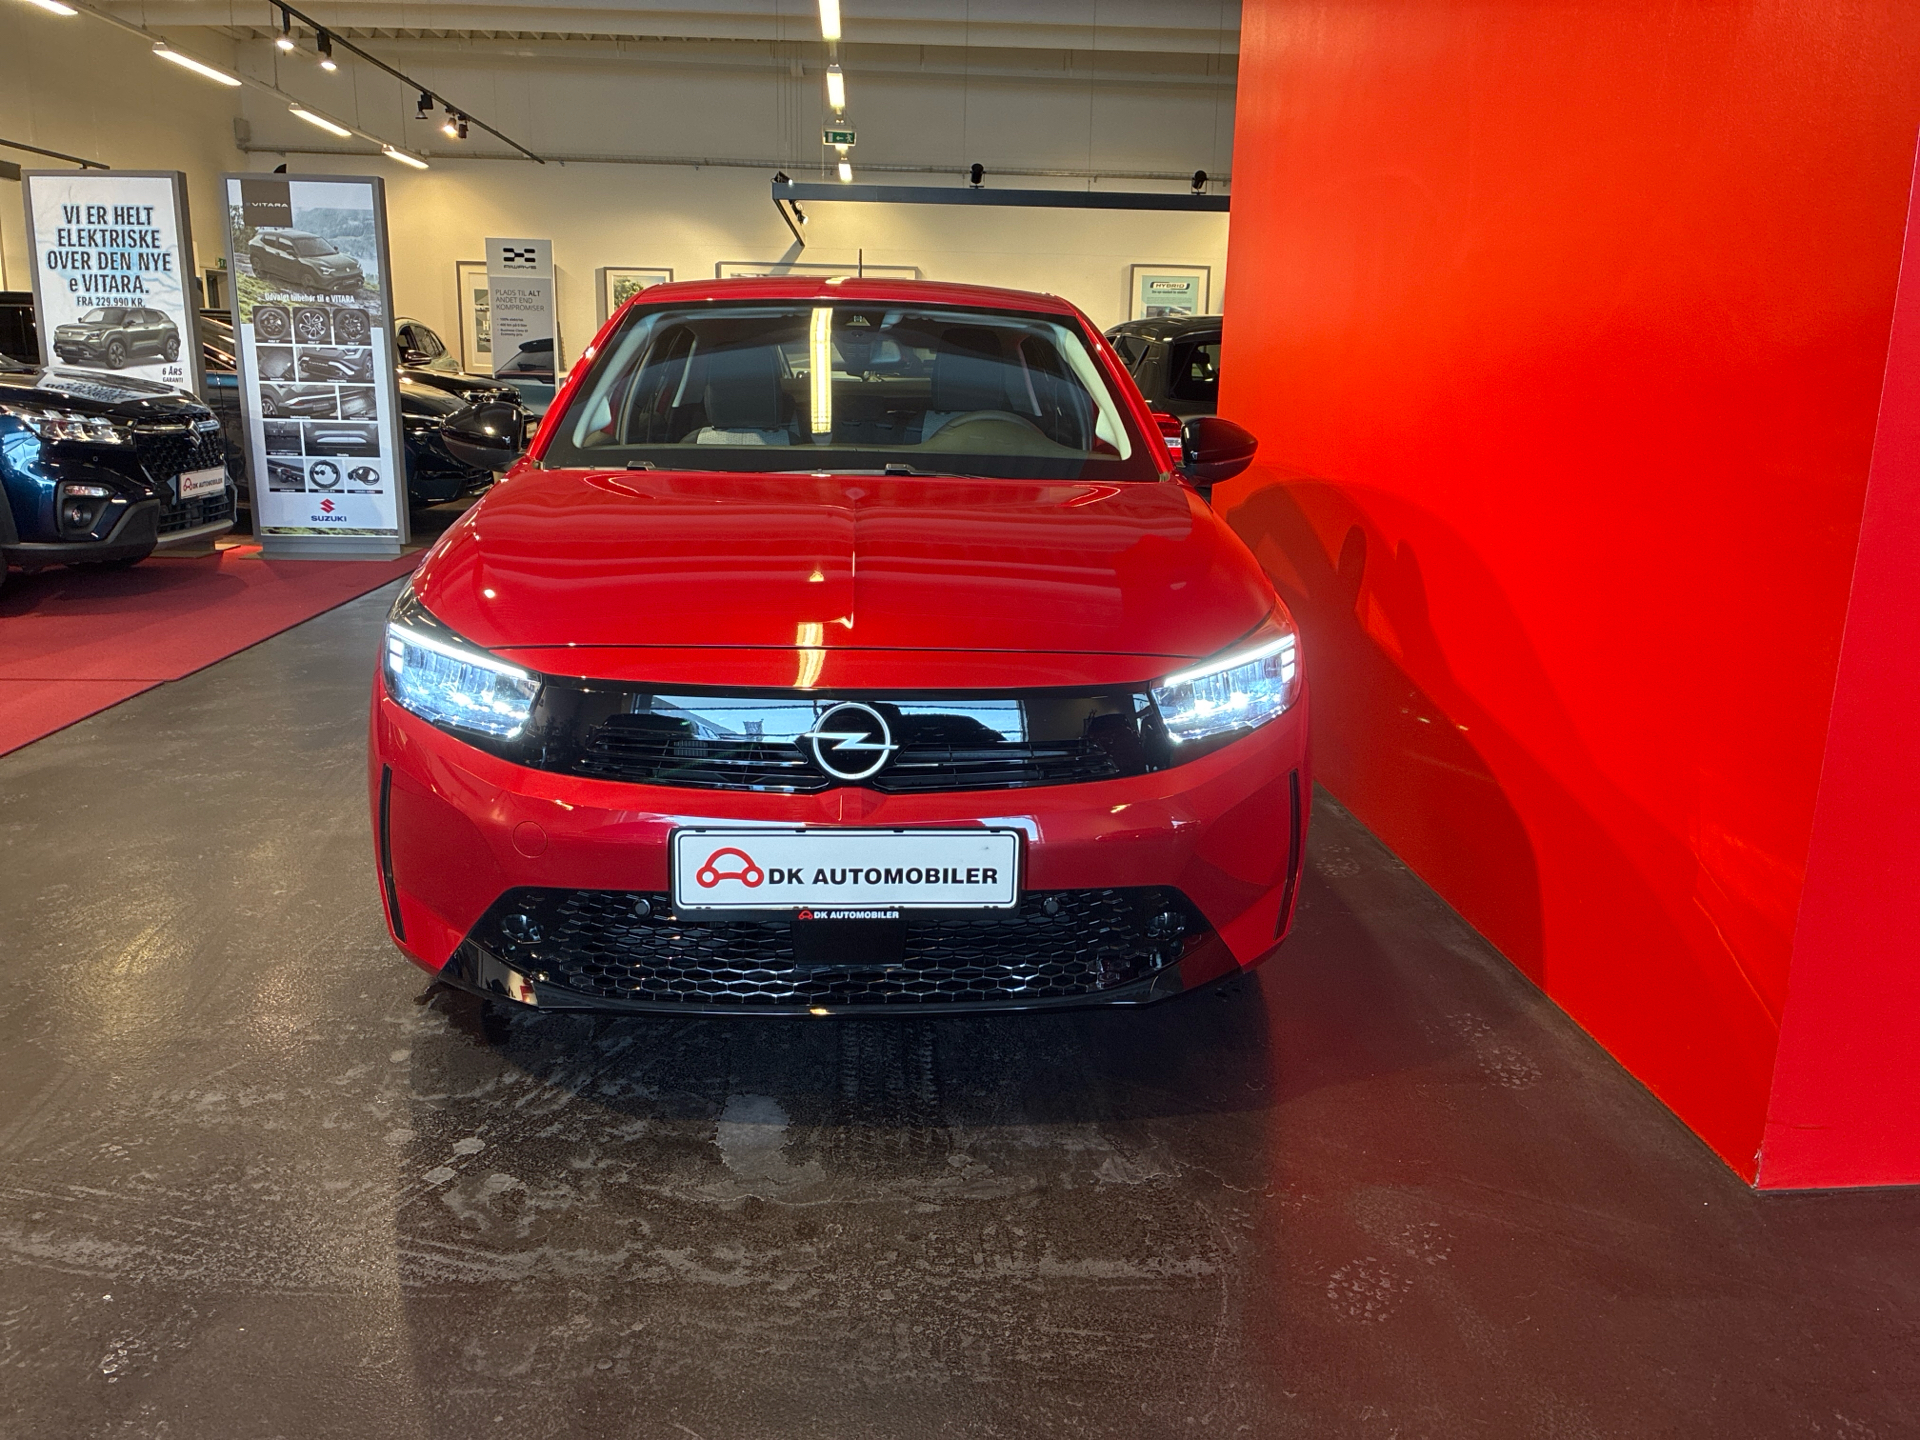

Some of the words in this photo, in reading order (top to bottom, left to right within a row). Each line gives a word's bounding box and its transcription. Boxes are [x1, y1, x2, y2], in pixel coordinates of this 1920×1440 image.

[64, 206, 80, 224] VI
[87, 206, 108, 225] ER
[114, 207, 154, 225] HELT
[57, 228, 161, 249] ELEKTRISKE
[47, 250, 91, 270] OVER
[97, 252, 131, 271] DEN
[138, 252, 171, 271] NYE
[69, 277, 78, 292] e
[81, 274, 150, 294] VITARA.
[76, 297, 93, 306] FRA
[95, 297, 129, 307] 229.990
[330, 295, 355, 303] VITARA
[162, 368, 167, 376] 6
[168, 365, 183, 376] ÅRS
[769, 868, 805, 885] DK
[812, 867, 998, 885] AUTOMOBILER
[813, 911, 829, 919] DK
[829, 911, 899, 919] AUTOMOBILER
